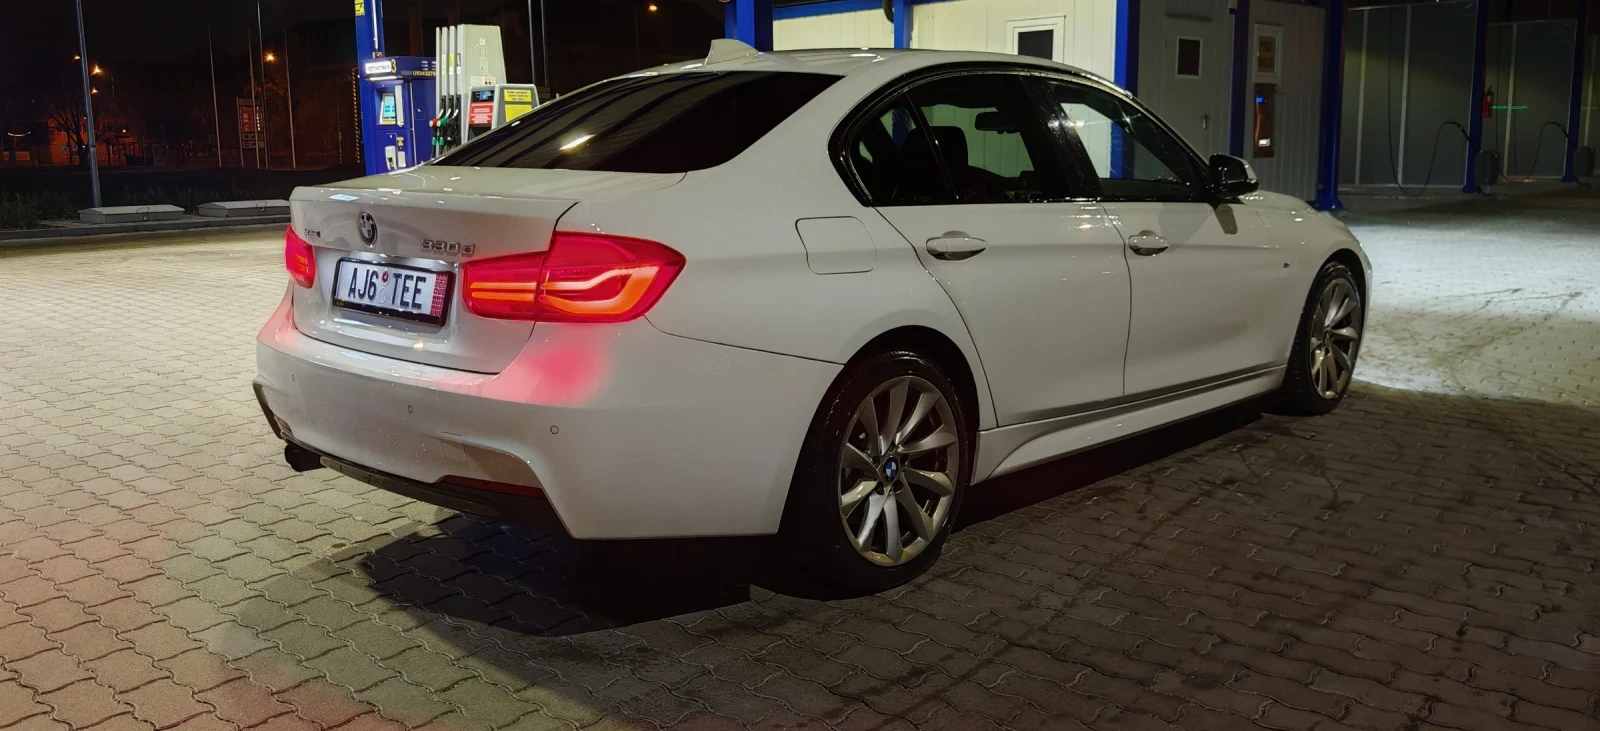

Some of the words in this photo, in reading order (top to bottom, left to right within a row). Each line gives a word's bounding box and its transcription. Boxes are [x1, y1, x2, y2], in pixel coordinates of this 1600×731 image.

[391, 58, 397, 74] 3
[347, 267, 379, 301] AJ6
[391, 272, 427, 309] TEE
